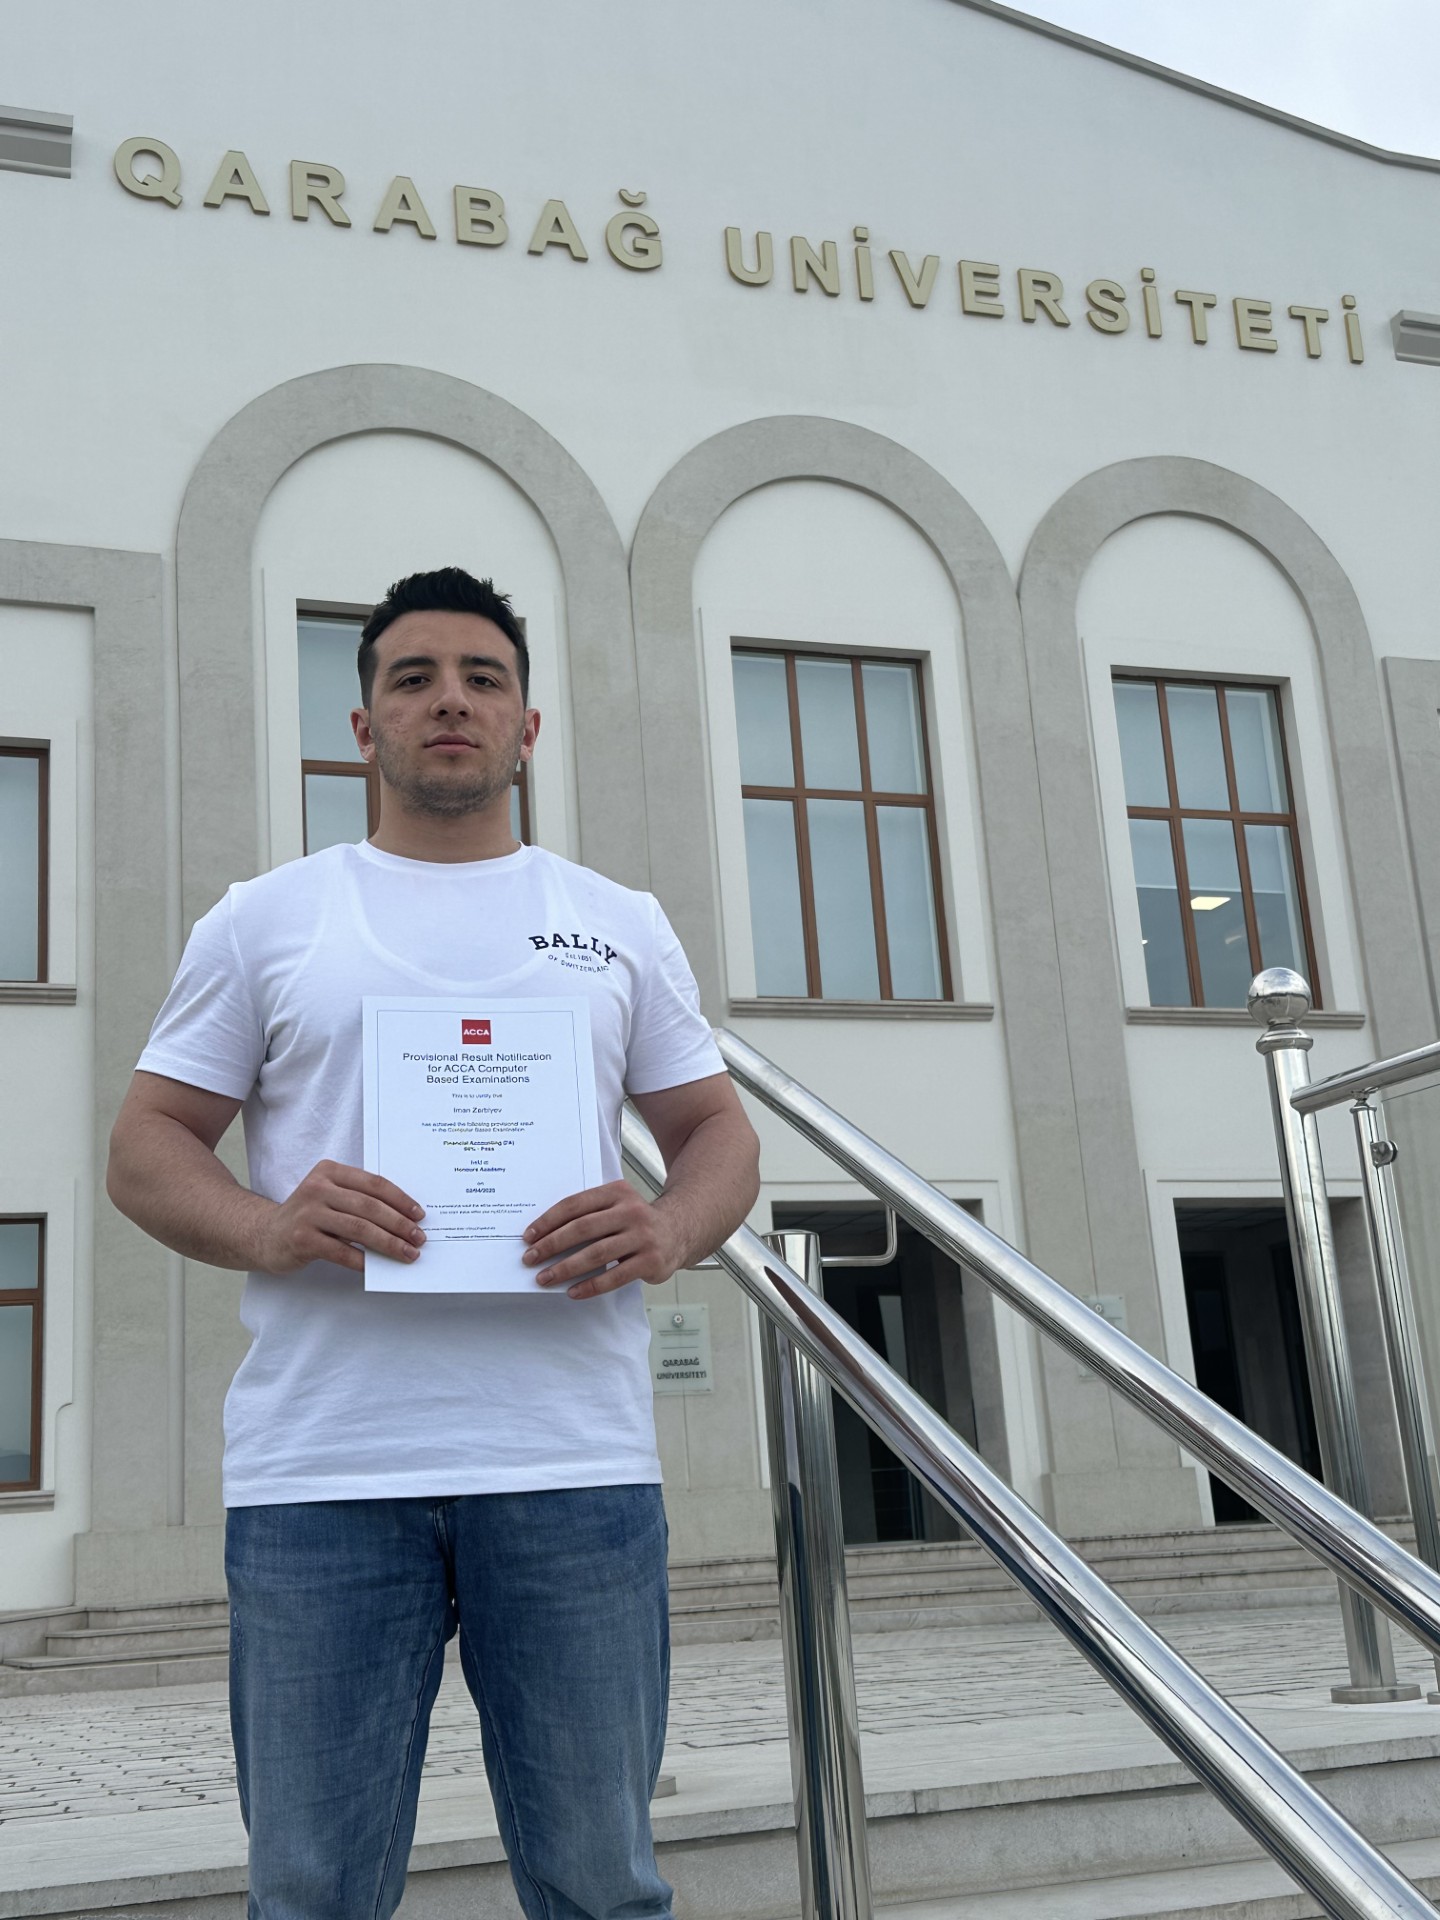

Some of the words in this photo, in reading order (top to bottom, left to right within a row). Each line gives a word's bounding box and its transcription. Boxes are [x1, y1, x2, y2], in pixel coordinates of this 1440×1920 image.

[113, 135, 664, 272] QARABAĞ
[723, 225, 1366, 365] UNİVERSİTETİ
[528, 933, 618, 965] BALLY
[463, 1028, 490, 1036] ACCA
[402, 1052, 458, 1061] Provisional
[461, 1053, 493, 1062] Result
[496, 1053, 552, 1061] Notification
[428, 1064, 441, 1073] for
[444, 1064, 476, 1073] ACCA
[477, 1064, 528, 1074] Computer
[426, 1075, 459, 1084] Based
[462, 1075, 530, 1084] Examinations
